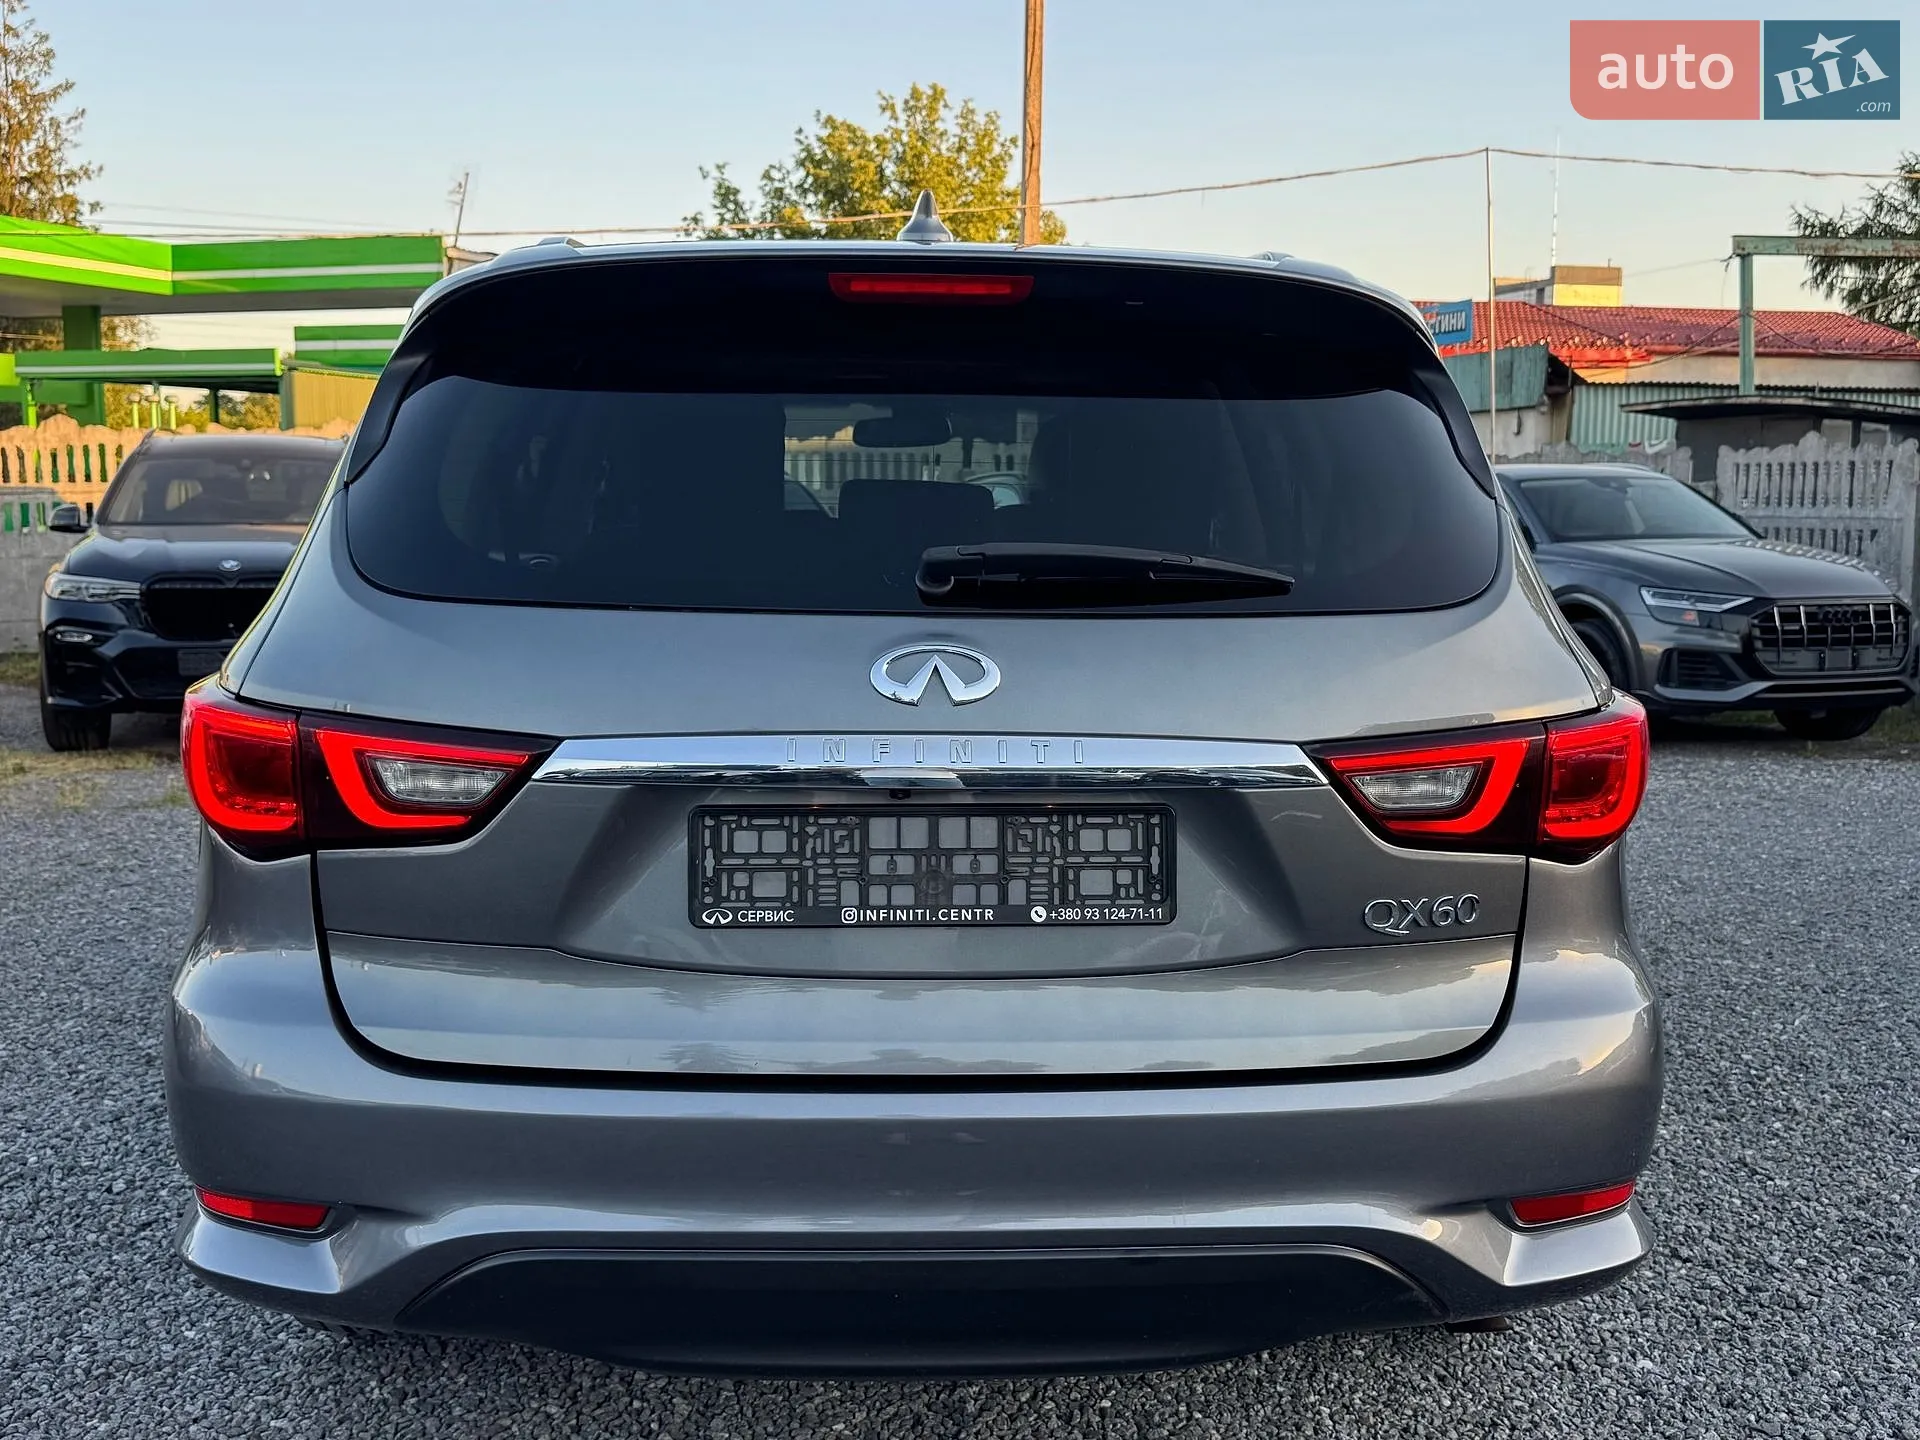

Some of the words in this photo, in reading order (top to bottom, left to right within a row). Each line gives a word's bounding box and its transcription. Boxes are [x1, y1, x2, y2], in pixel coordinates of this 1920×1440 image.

[787, 737, 1084, 764] INFINITI
[737, 910, 795, 922] СЕРВИС
[860, 908, 995, 921] INFINITI.CENTR
[1050, 908, 1081, 920] +380
[1084, 908, 1100, 920] 93
[1103, 908, 1162, 920] 124-71-11
[1364, 893, 1480, 937] QX60
